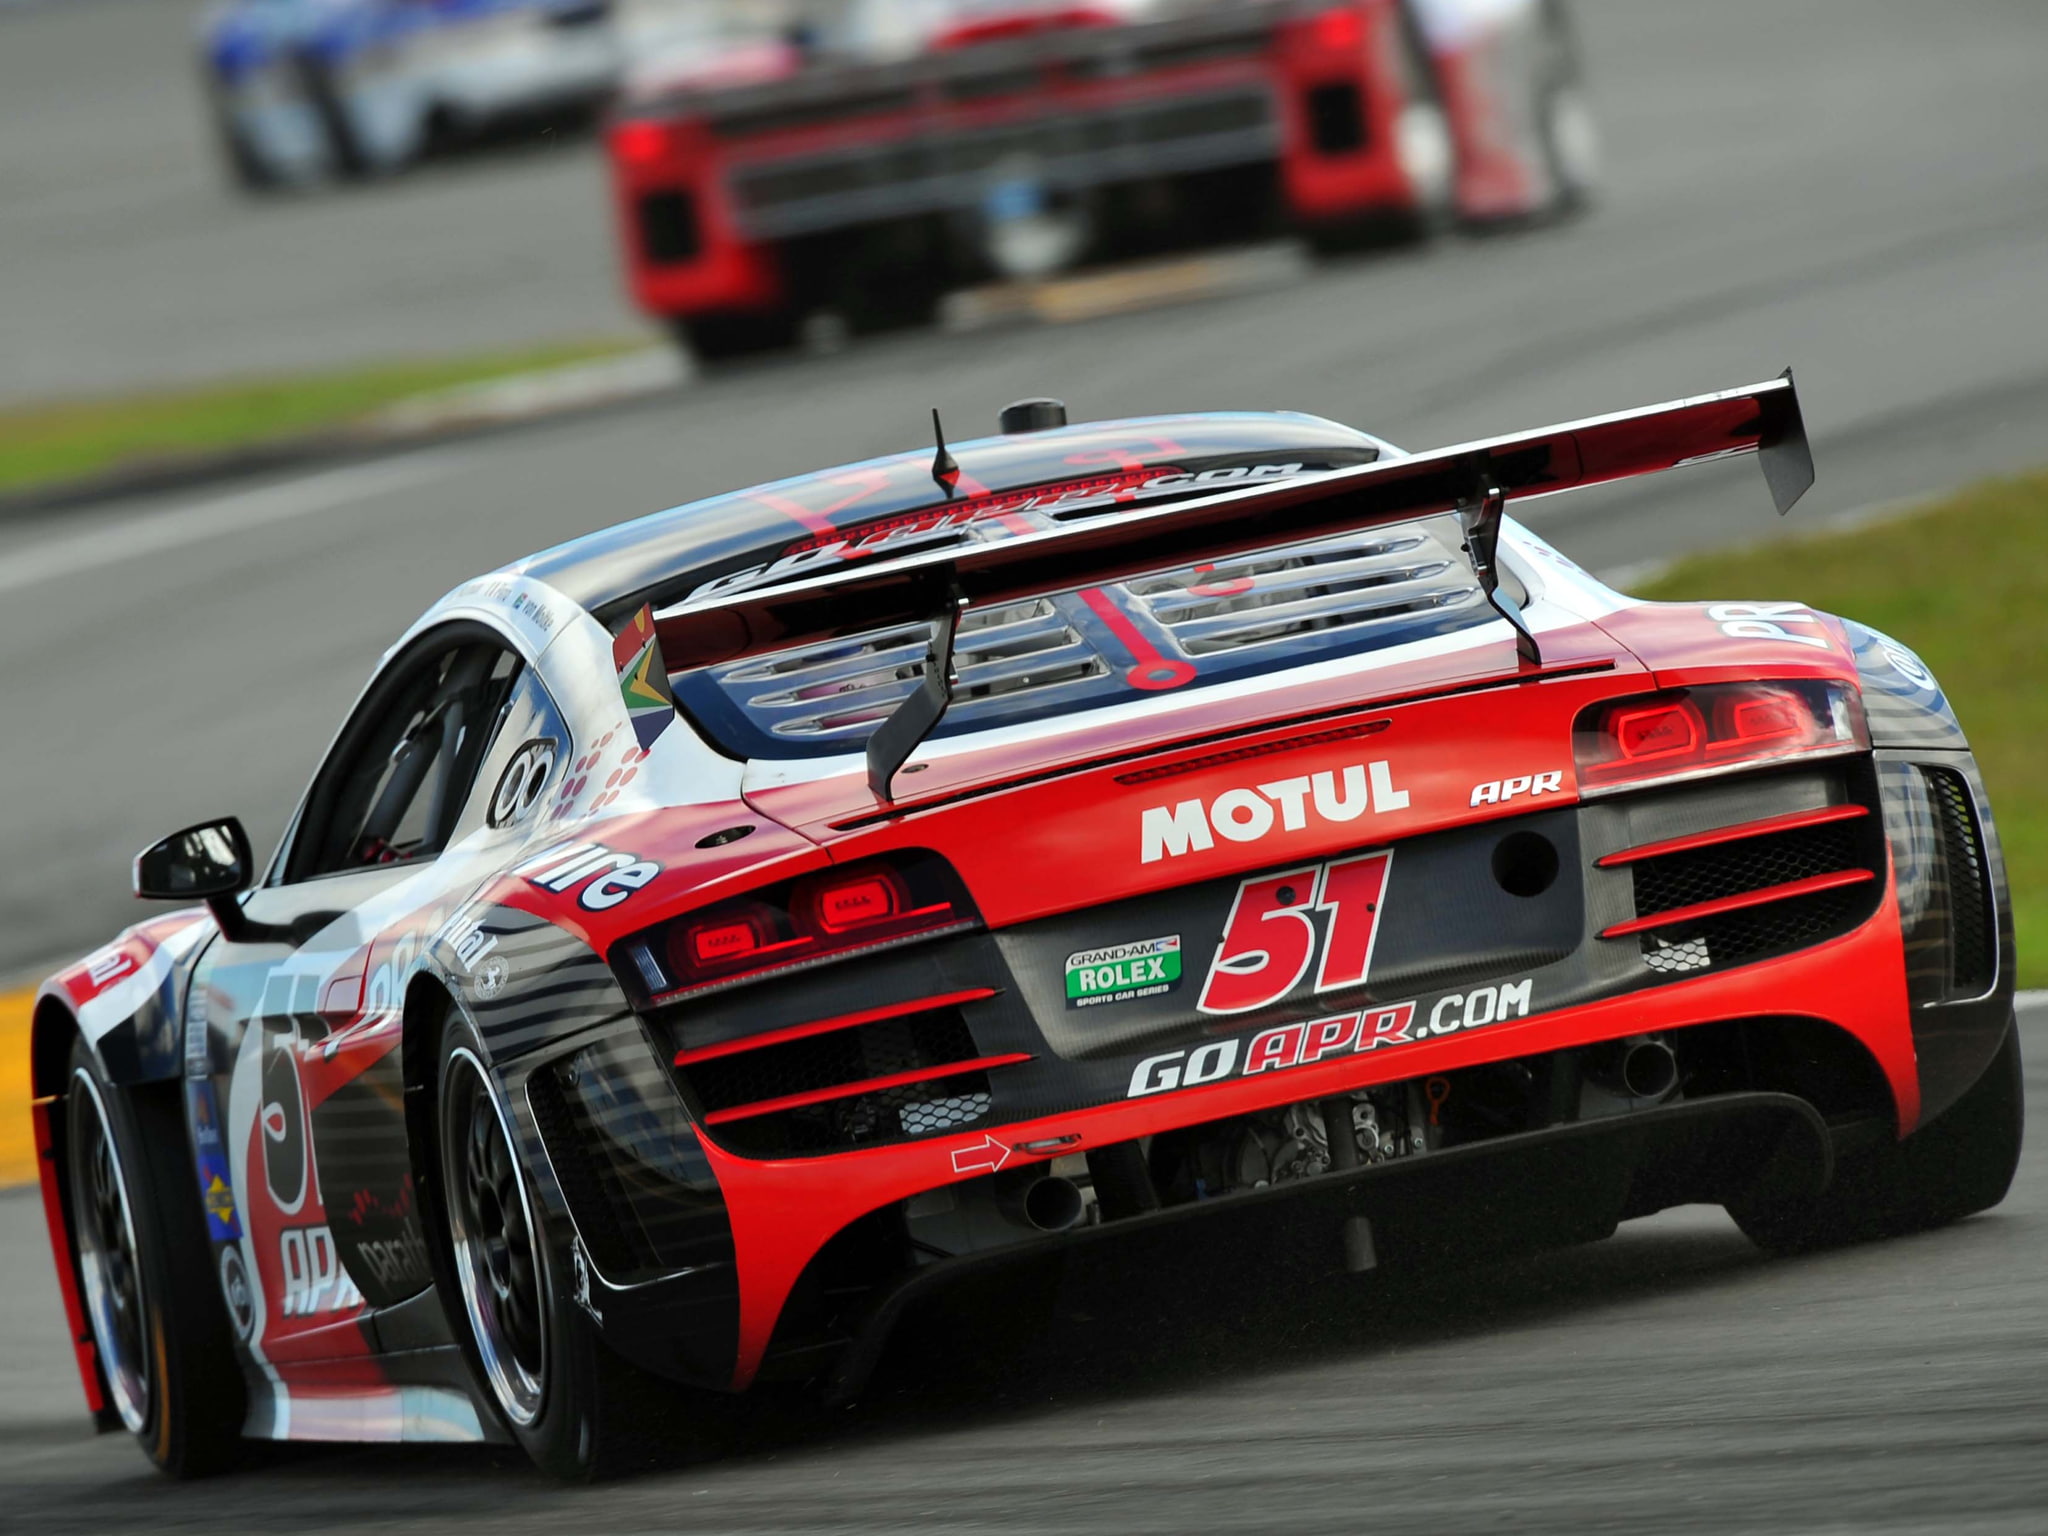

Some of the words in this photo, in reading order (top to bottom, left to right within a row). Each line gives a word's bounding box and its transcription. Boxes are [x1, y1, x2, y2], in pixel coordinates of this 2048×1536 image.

[1469, 770, 1562, 807] APR
[1141, 760, 1410, 864] MOTUL
[1196, 848, 1394, 1015] 51
[1079, 956, 1166, 992] ROLEX
[1076, 994, 1113, 1007] SPORTS
[1115, 990, 1135, 1001] CAR
[1136, 984, 1170, 997] SERIES
